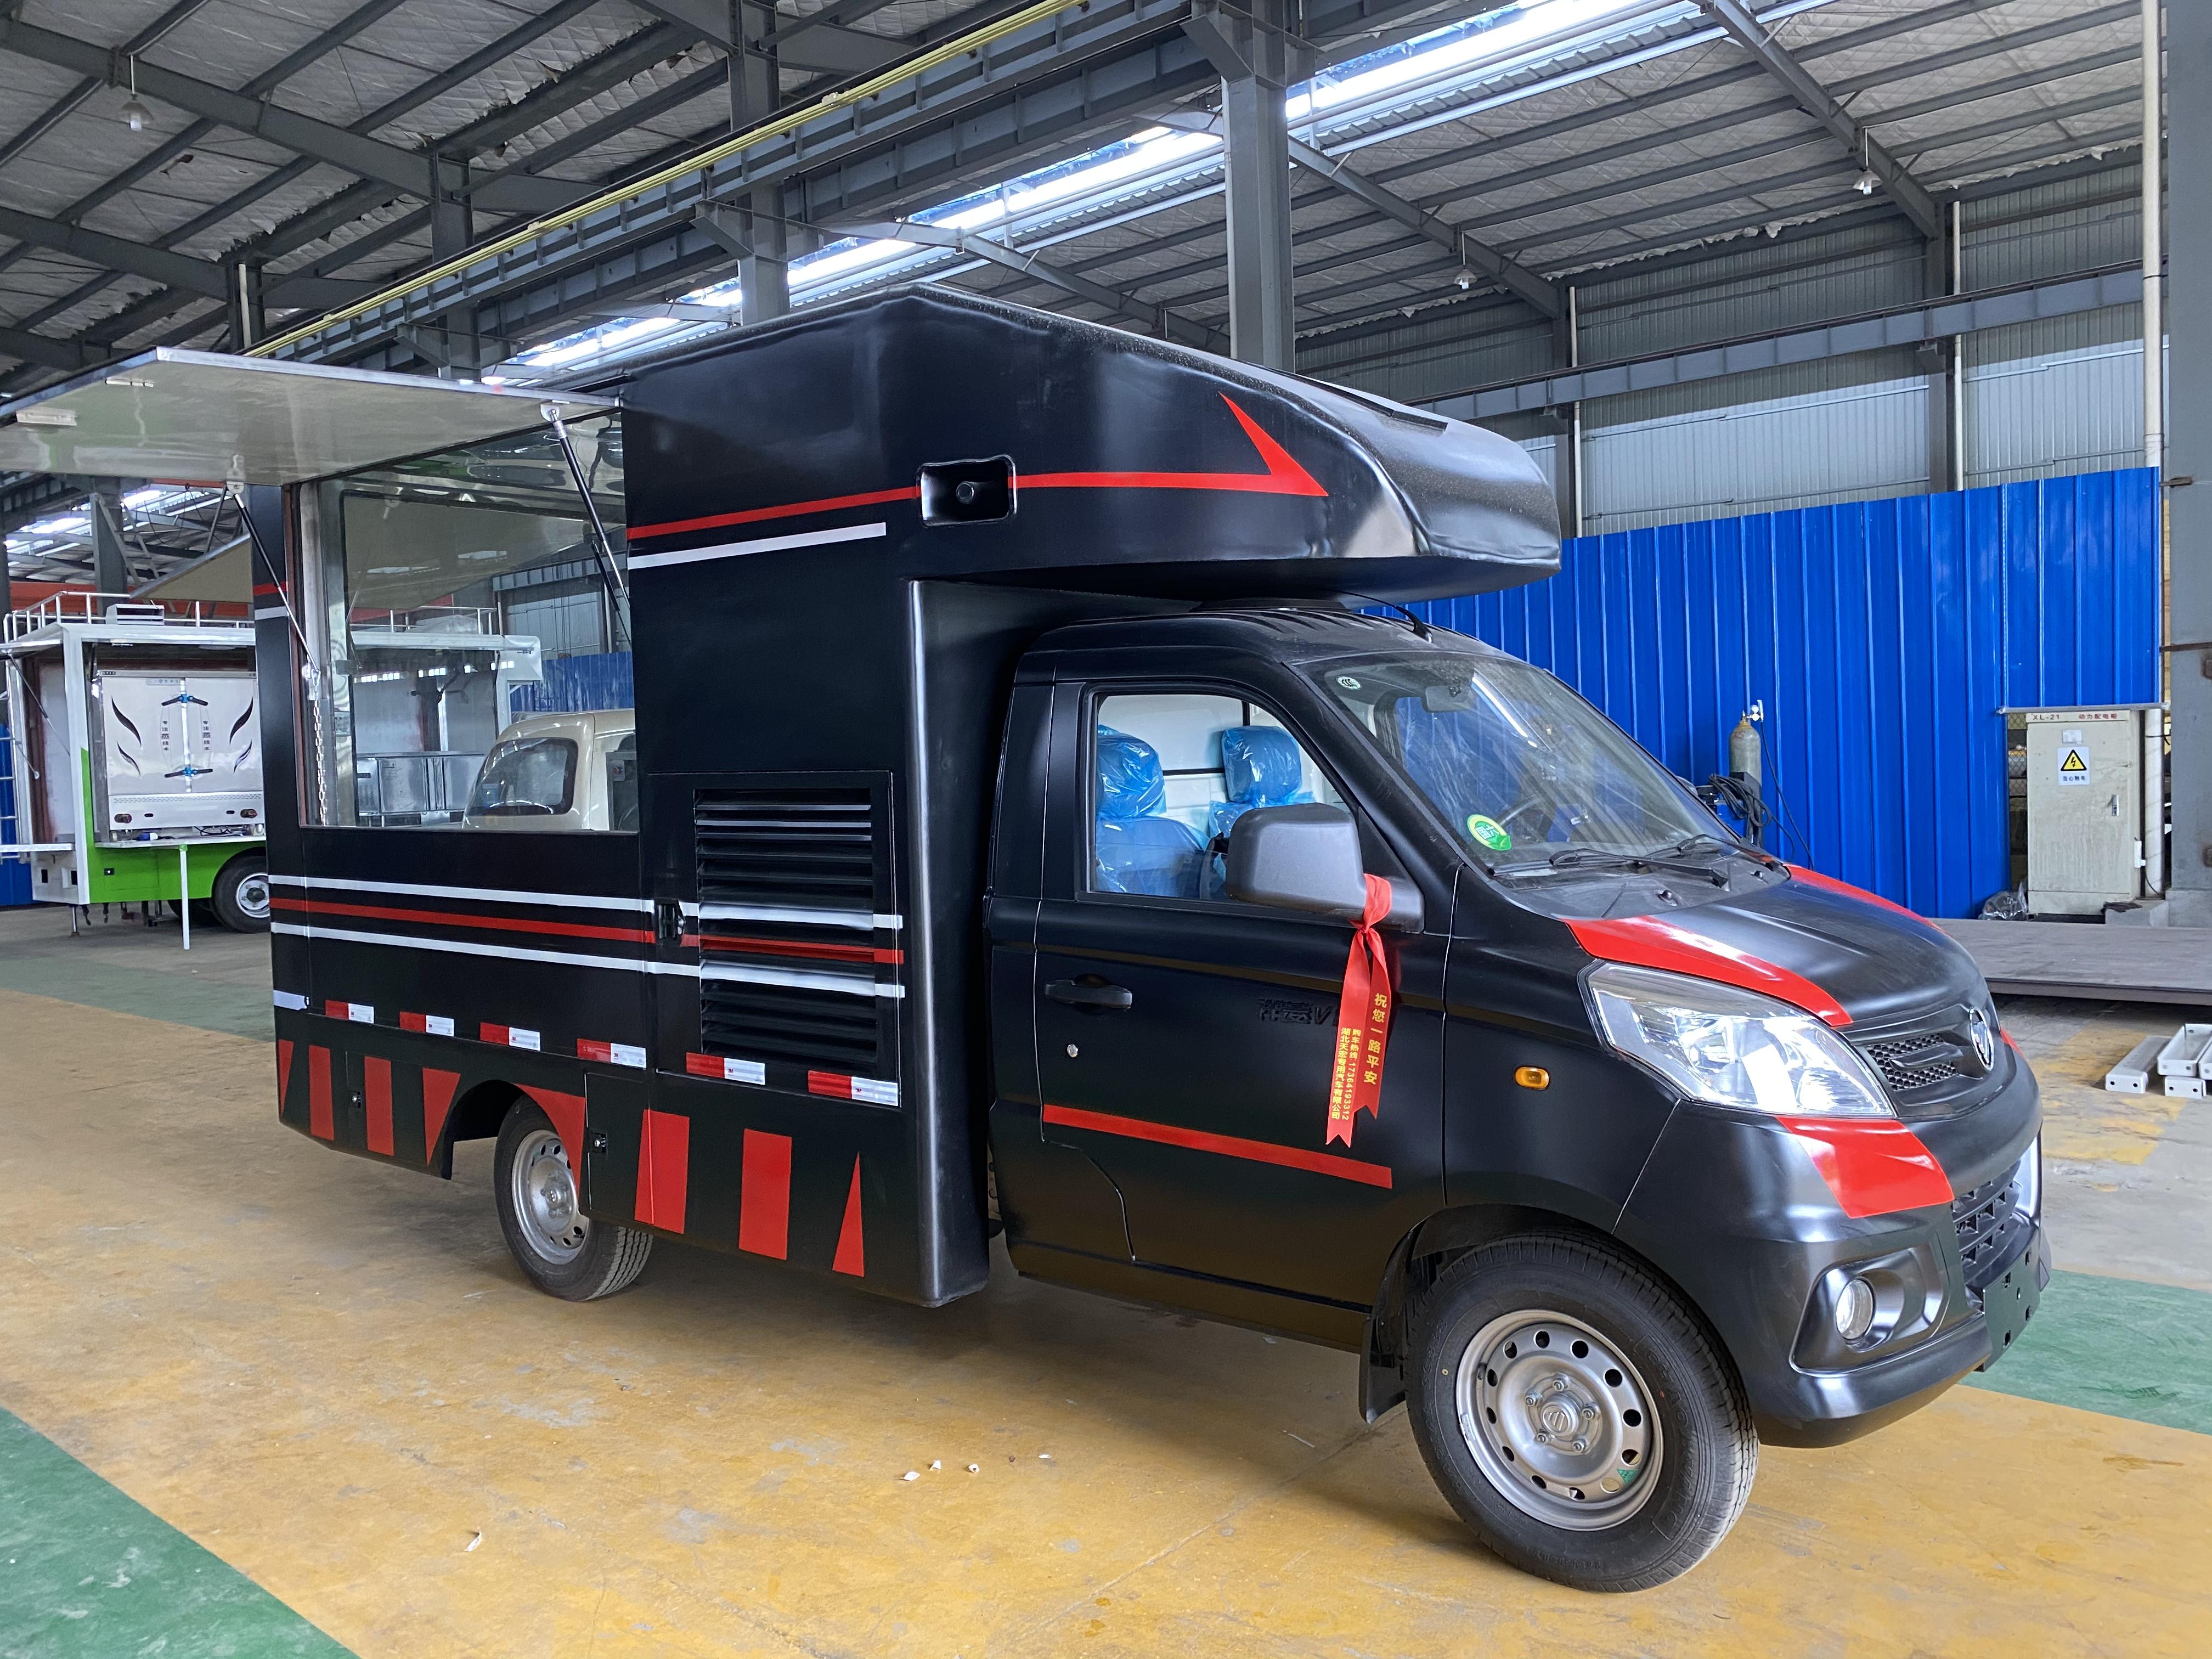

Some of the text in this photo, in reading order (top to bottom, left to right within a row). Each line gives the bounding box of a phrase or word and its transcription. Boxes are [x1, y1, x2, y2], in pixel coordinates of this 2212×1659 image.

[1363, 992, 1388, 1085] 祝您一路平安
